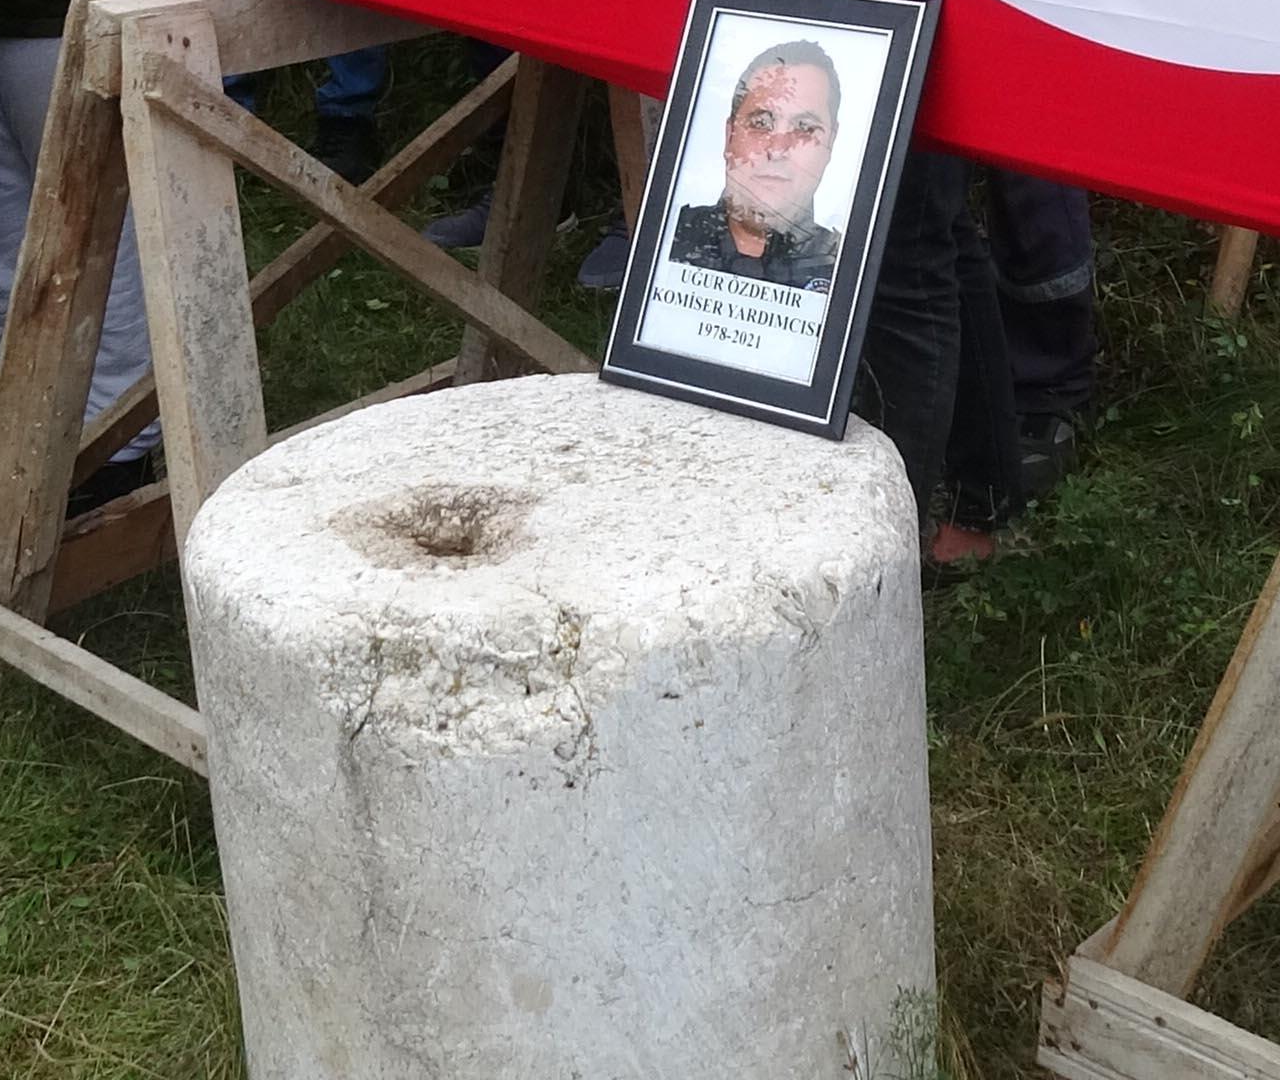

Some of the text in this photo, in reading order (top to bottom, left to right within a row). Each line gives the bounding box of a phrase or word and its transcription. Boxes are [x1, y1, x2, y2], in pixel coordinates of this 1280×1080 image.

[681, 267, 802, 308] UĞUR ÖZDEMİR
[652, 286, 821, 337] KOMİSER YARDIMCISI
[697, 321, 761, 349] 1978-2021
